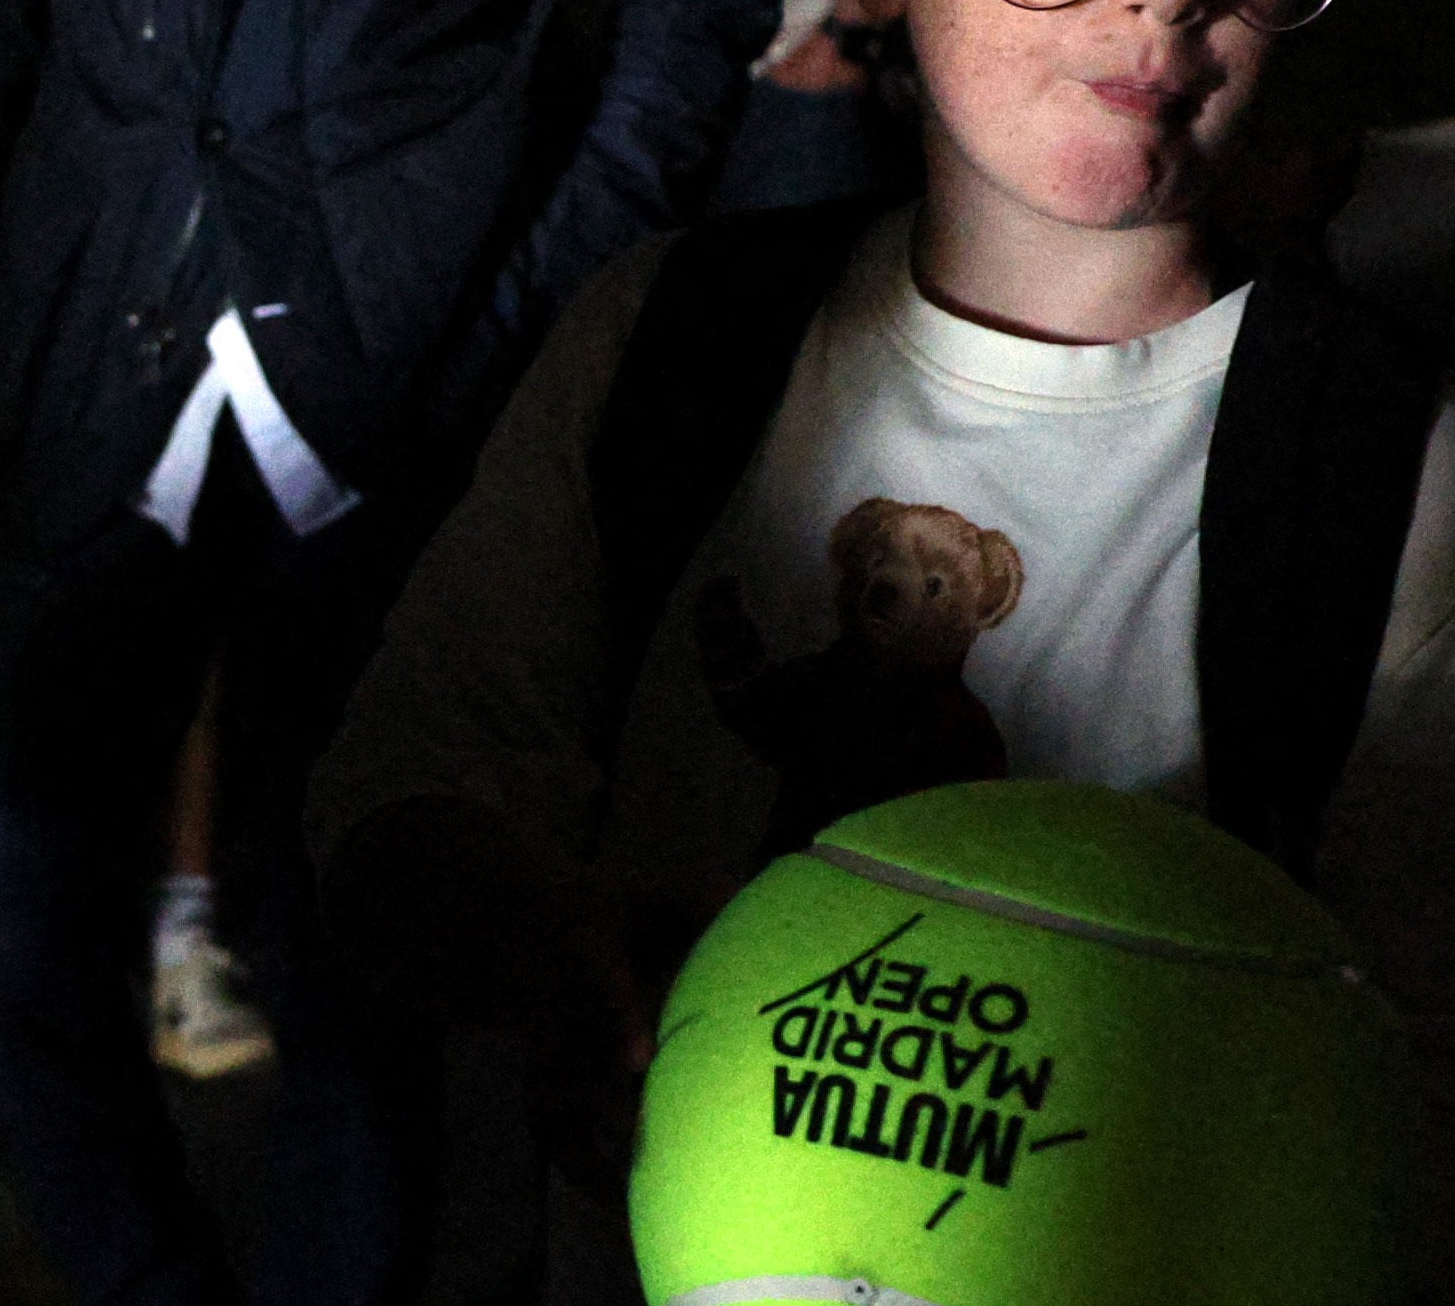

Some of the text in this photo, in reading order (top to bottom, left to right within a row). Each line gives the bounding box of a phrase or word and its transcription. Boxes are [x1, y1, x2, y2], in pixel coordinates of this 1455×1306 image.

[824, 958, 1028, 1033] OPEN
[773, 1006, 1052, 1110] MADRID
[774, 1066, 1024, 1187] MUTUA
